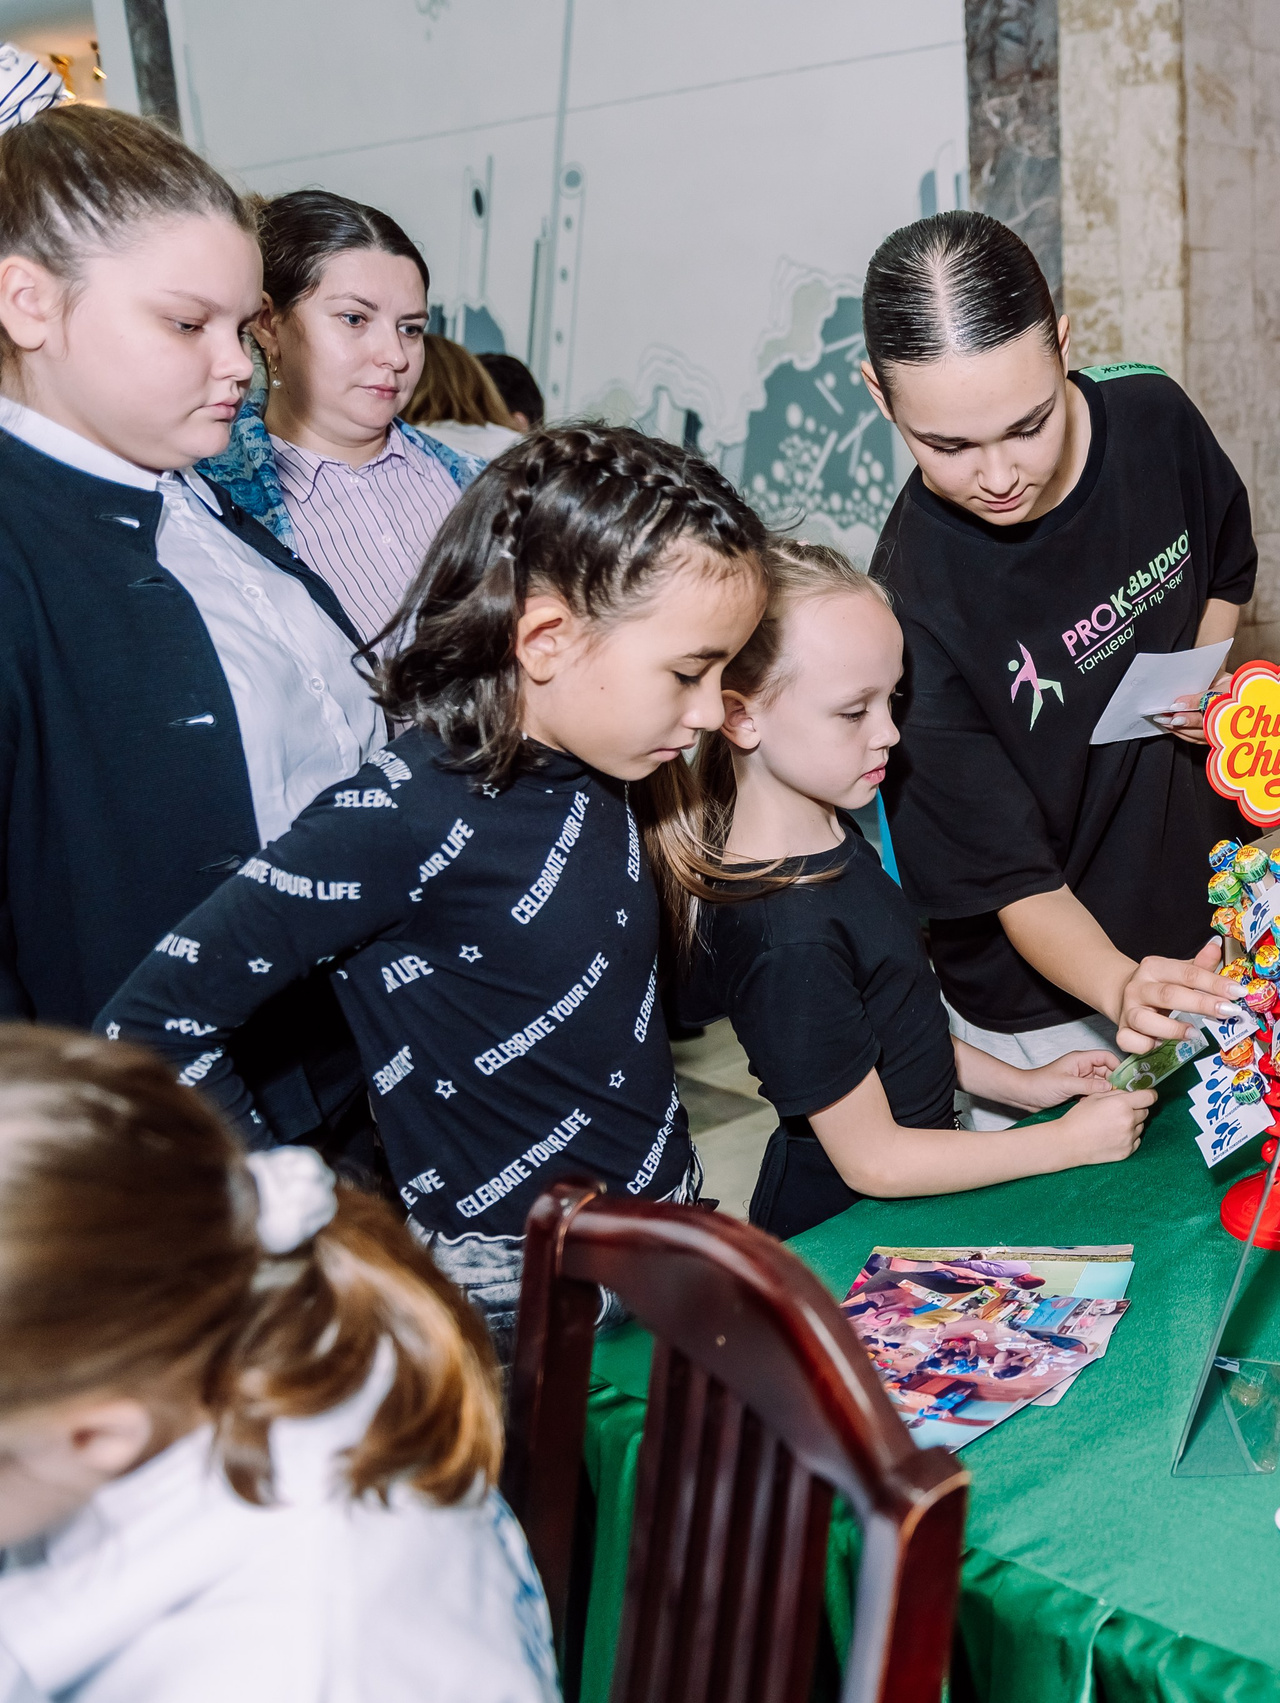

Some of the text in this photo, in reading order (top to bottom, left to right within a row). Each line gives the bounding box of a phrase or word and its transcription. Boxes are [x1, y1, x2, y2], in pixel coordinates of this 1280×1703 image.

[270, 867, 313, 898] YOUR
[317, 880, 361, 900] LIFE
[419, 818, 475, 883] UR LIFE
[511, 791, 590, 924] CELEBRATE YOUR LIFE
[391, 955, 434, 984] LIFE
[474, 1015, 556, 1076] CELEBRATE
[547, 984, 589, 1022] YOUR
[582, 952, 609, 989] LIFE
[634, 970, 657, 1043] CELEBRATE
[456, 1159, 532, 1218] CELEBRATE
[521, 1134, 568, 1168] YOUR
[553, 1108, 592, 1142] LIFE
[626, 1124, 673, 1195] CELEBRATE
